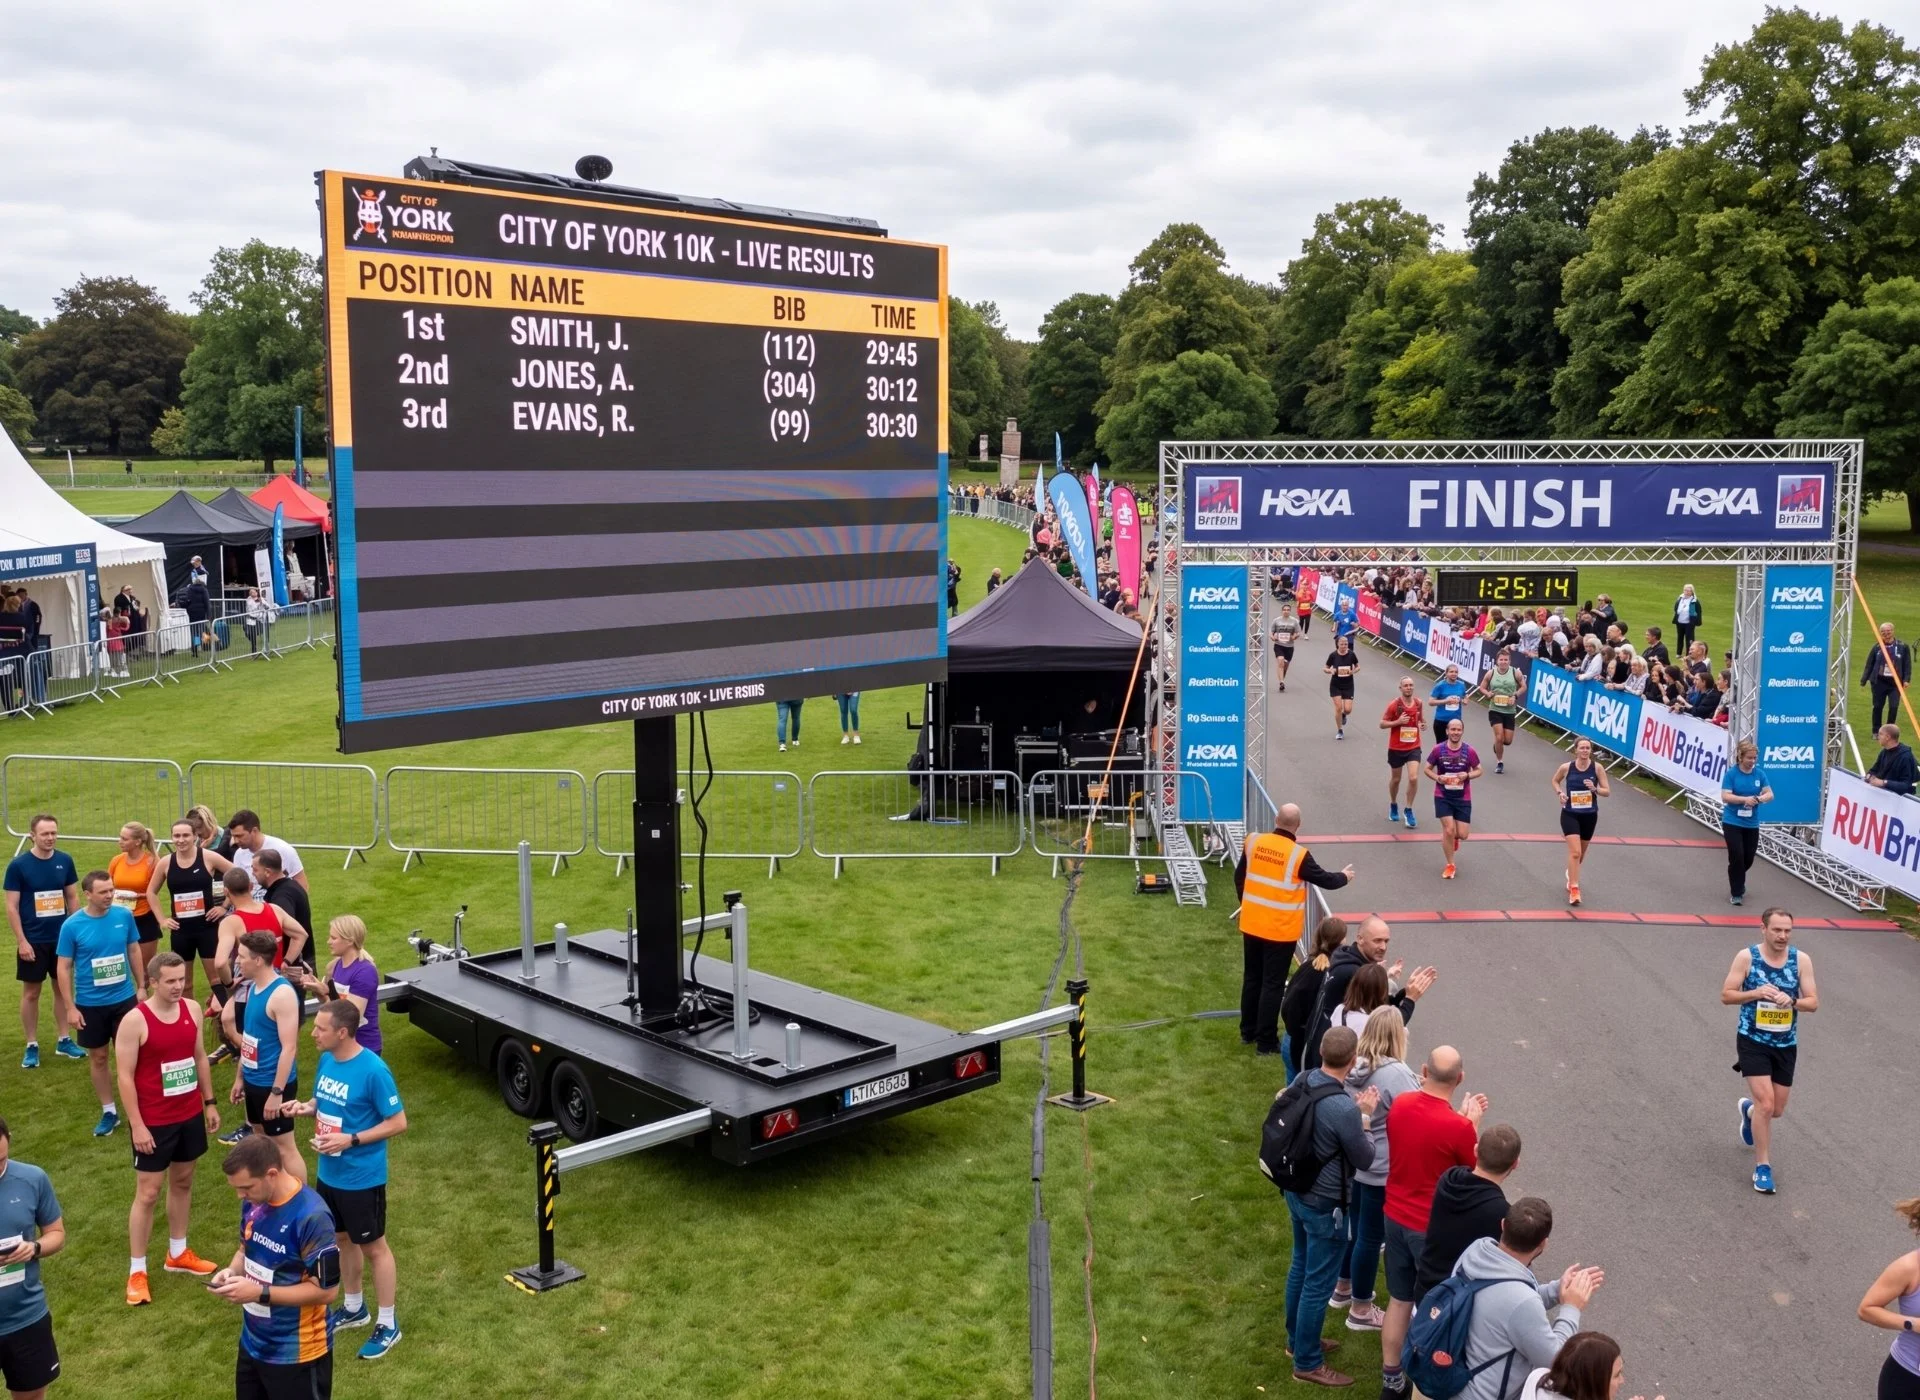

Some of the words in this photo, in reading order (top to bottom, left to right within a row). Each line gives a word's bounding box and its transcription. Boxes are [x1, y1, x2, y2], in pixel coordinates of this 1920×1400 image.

[400, 194, 422, 205] CITY
[424, 197, 438, 206] OF
[386, 205, 454, 232] YORK
[499, 213, 557, 247] CITY
[565, 221, 596, 250] OF
[603, 225, 667, 259] YORK
[673, 233, 715, 263] 10K
[736, 239, 782, 270] LIVE
[787, 245, 874, 279] RESULTS
[359, 260, 492, 299] POSITION
[511, 273, 584, 306] NAME
[773, 296, 806, 321] BIB
[871, 304, 916, 330] TIME
[402, 309, 445, 341] 1st
[511, 316, 600, 354] SMITH,
[607, 322, 629, 351] J.
[763, 331, 816, 367] (112)
[866, 340, 917, 367] 29:45
[398, 353, 449, 385] 2nd
[511, 358, 602, 396] JONES,
[609, 363, 634, 391] A.
[763, 369, 816, 405] (304)
[867, 376, 918, 402] 30:12
[402, 398, 448, 429] 3rd
[513, 401, 605, 437] EVANS,
[611, 404, 635, 432] R.
[770, 407, 810, 442] (99)
[866, 412, 918, 438] 30:30
[1260, 488, 1353, 516] HOKA
[1408, 479, 1612, 528] FINISH
[1666, 487, 1760, 515] HOKA
[1188, 587, 1240, 603] HOKA
[1479, 577, 1569, 599] 1:25:14
[1771, 587, 1824, 603] HOKA
[602, 698, 629, 715] CITY
[631, 696, 647, 712] OF
[648, 694, 678, 710] YORK
[680, 691, 702, 706] 10K
[709, 686, 733, 702] LIVE
[1532, 669, 1573, 718] HOKA
[1582, 690, 1630, 743] HOKA
[1186, 744, 1237, 760] HOKA
[1763, 746, 1816, 762] HOKA
[317, 1074, 349, 1100] HOKA
